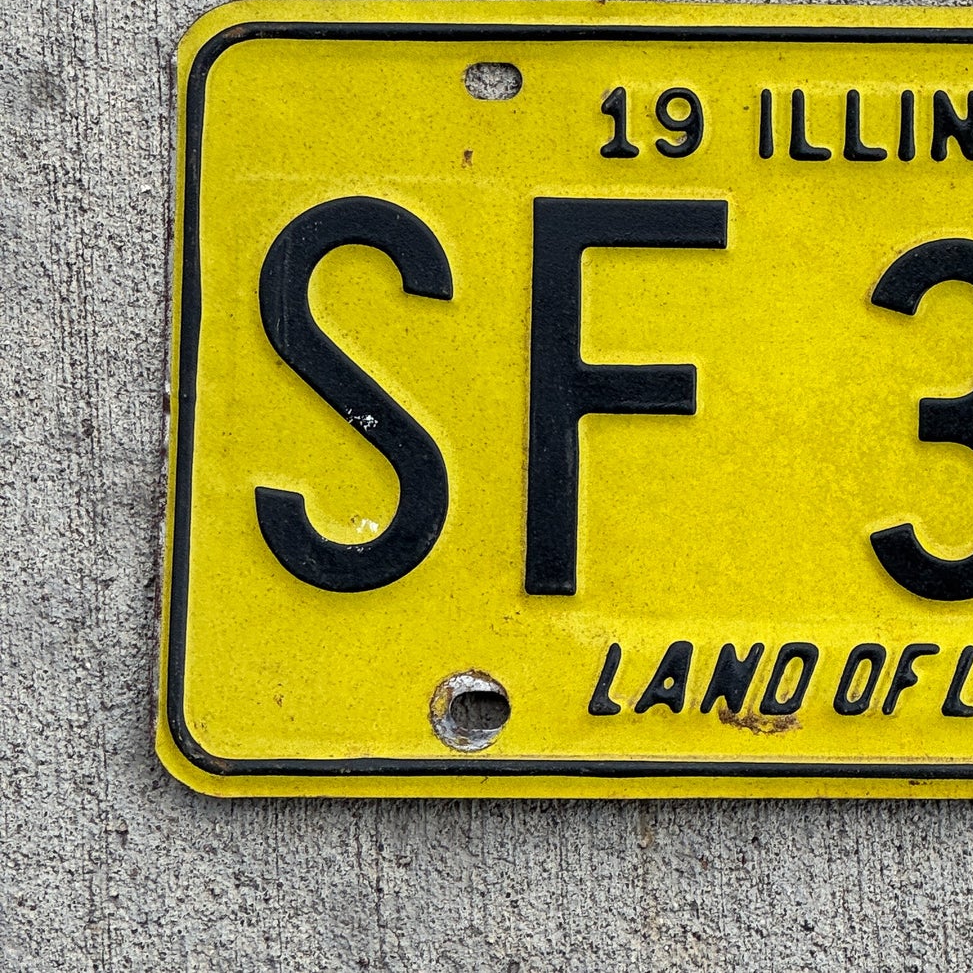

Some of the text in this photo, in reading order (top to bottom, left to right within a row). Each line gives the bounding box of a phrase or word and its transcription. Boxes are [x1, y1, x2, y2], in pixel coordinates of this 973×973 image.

[600, 87, 704, 158] 19
[255, 196, 728, 596] SF
[588, 641, 818, 716] LAND
[833, 642, 939, 716] OF
